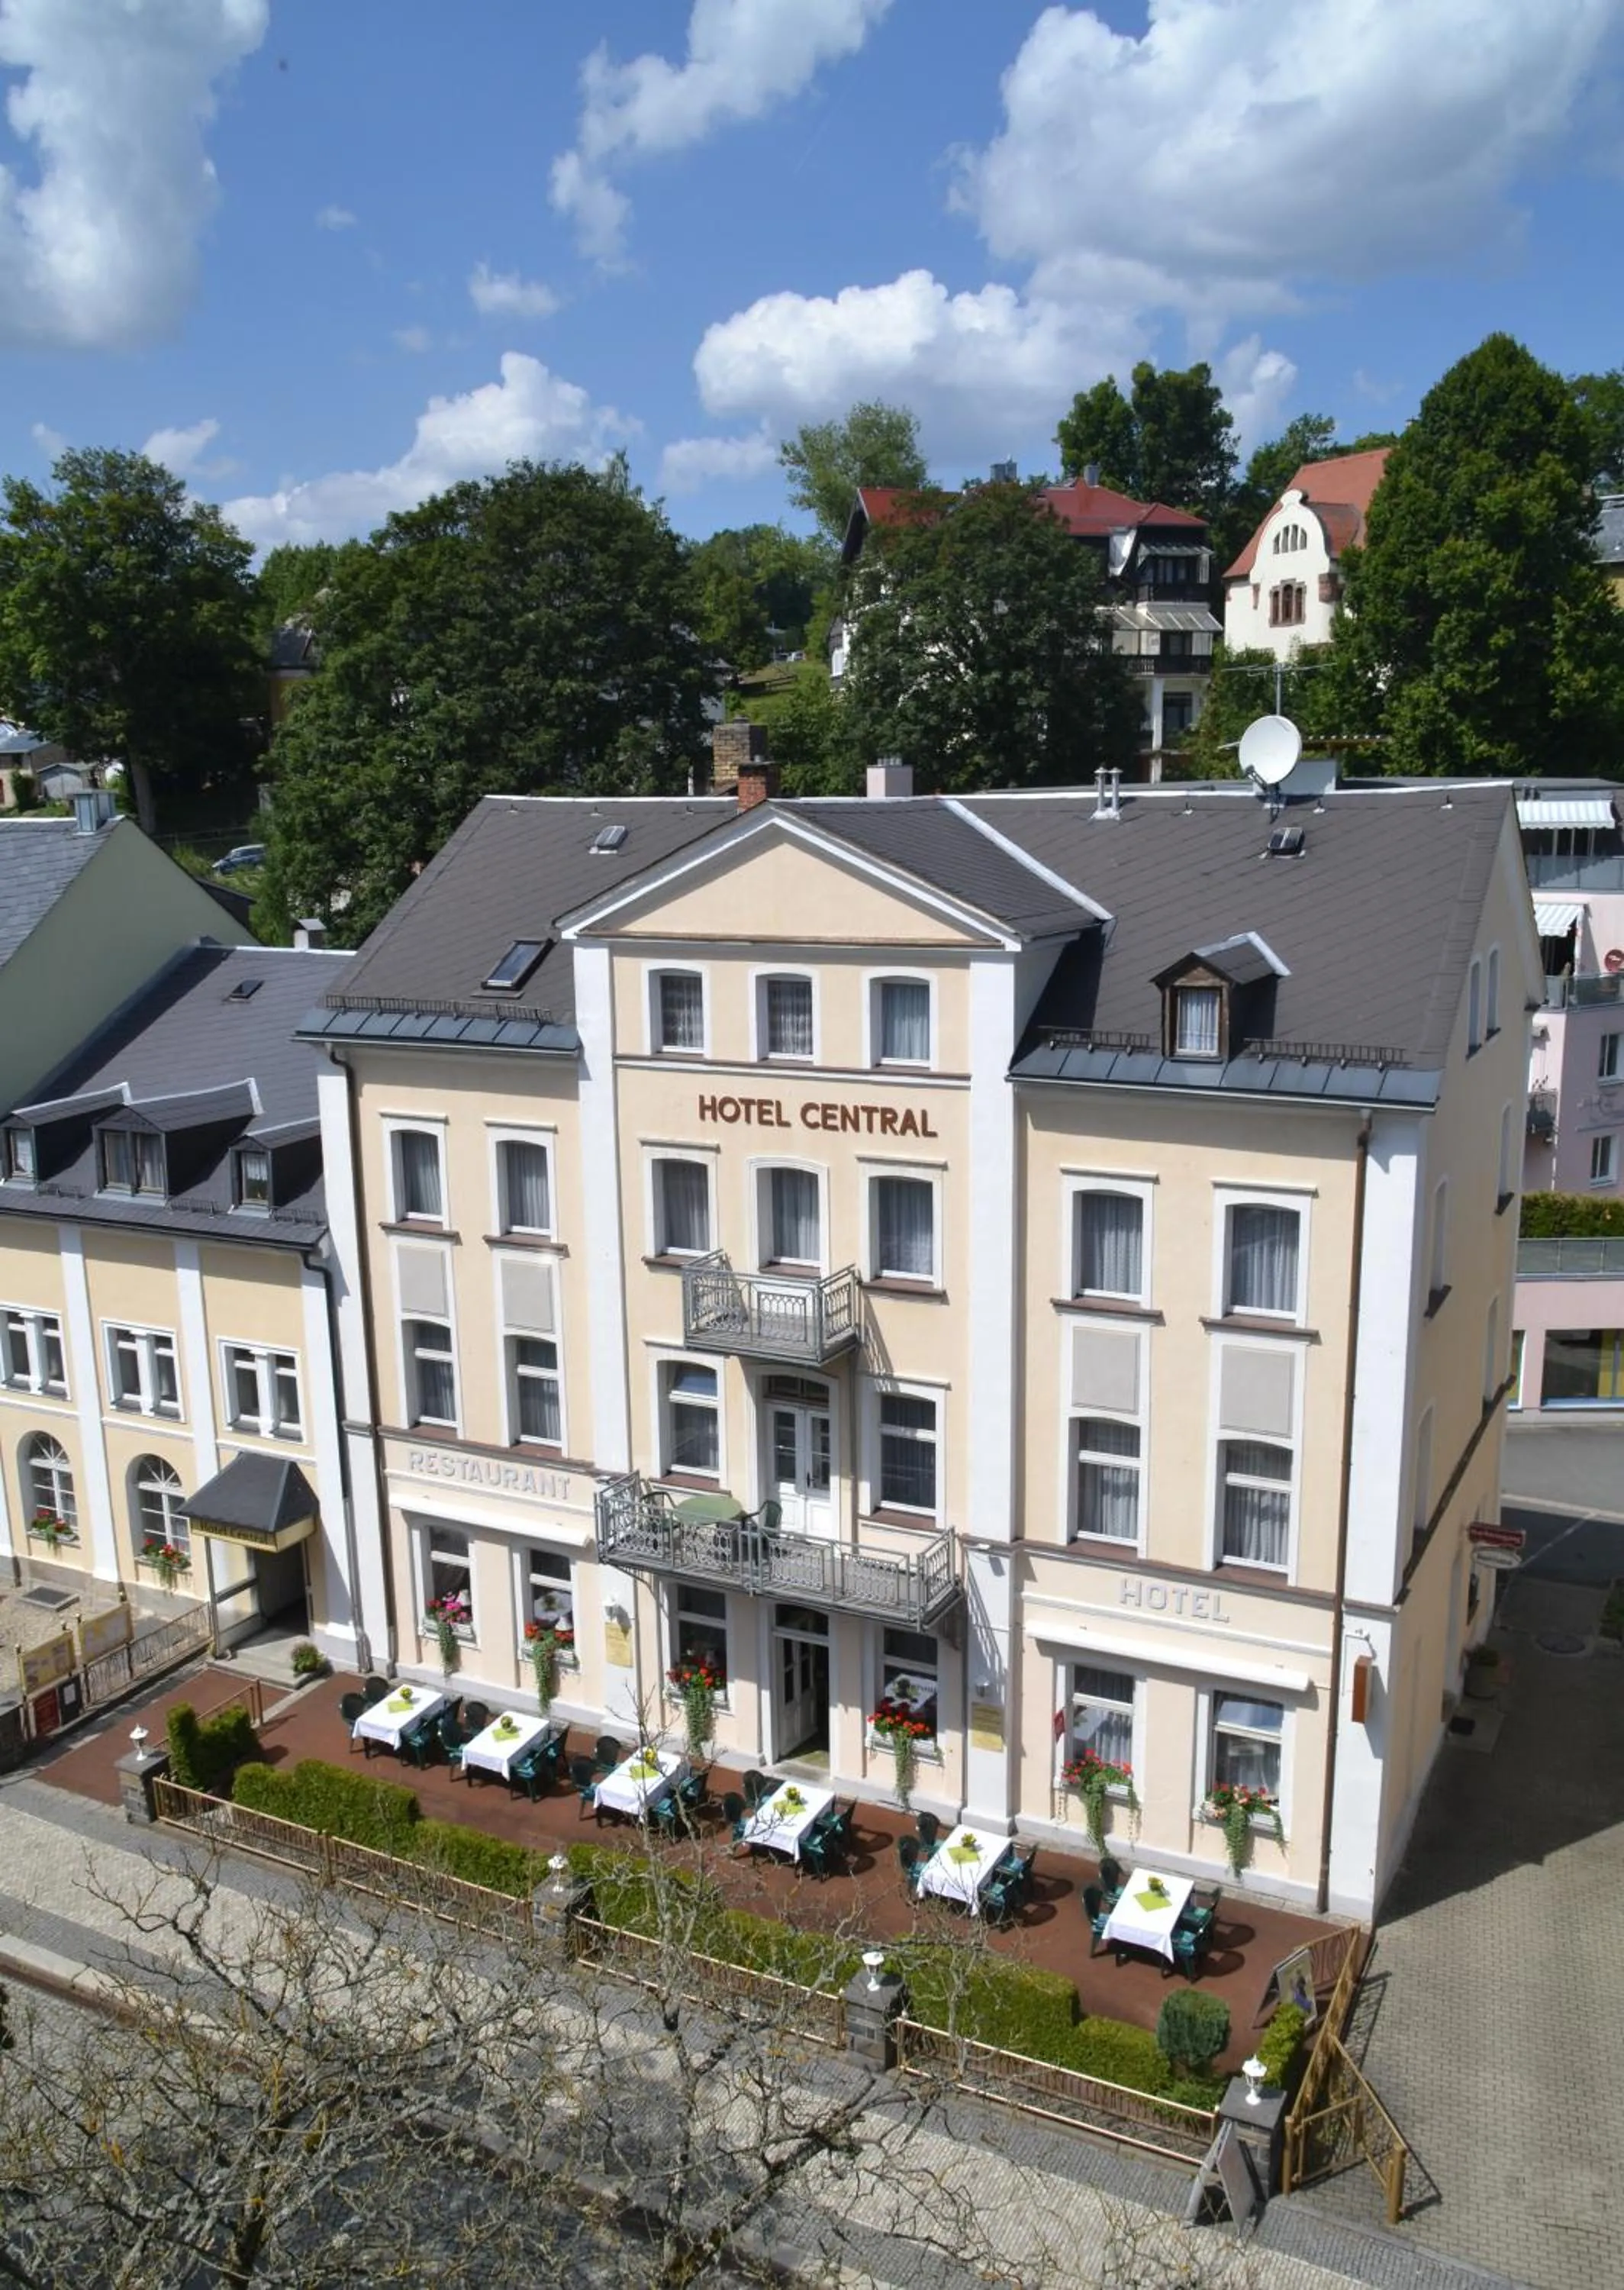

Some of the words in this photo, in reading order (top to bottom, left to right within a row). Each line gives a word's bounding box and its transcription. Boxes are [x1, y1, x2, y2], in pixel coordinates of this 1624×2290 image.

[699, 1095, 791, 1127] HOTEL
[800, 1101, 938, 1137] CENTRAL
[409, 1451, 571, 1499] RESTAURANT
[1120, 1579, 1229, 1623] HOTEL
